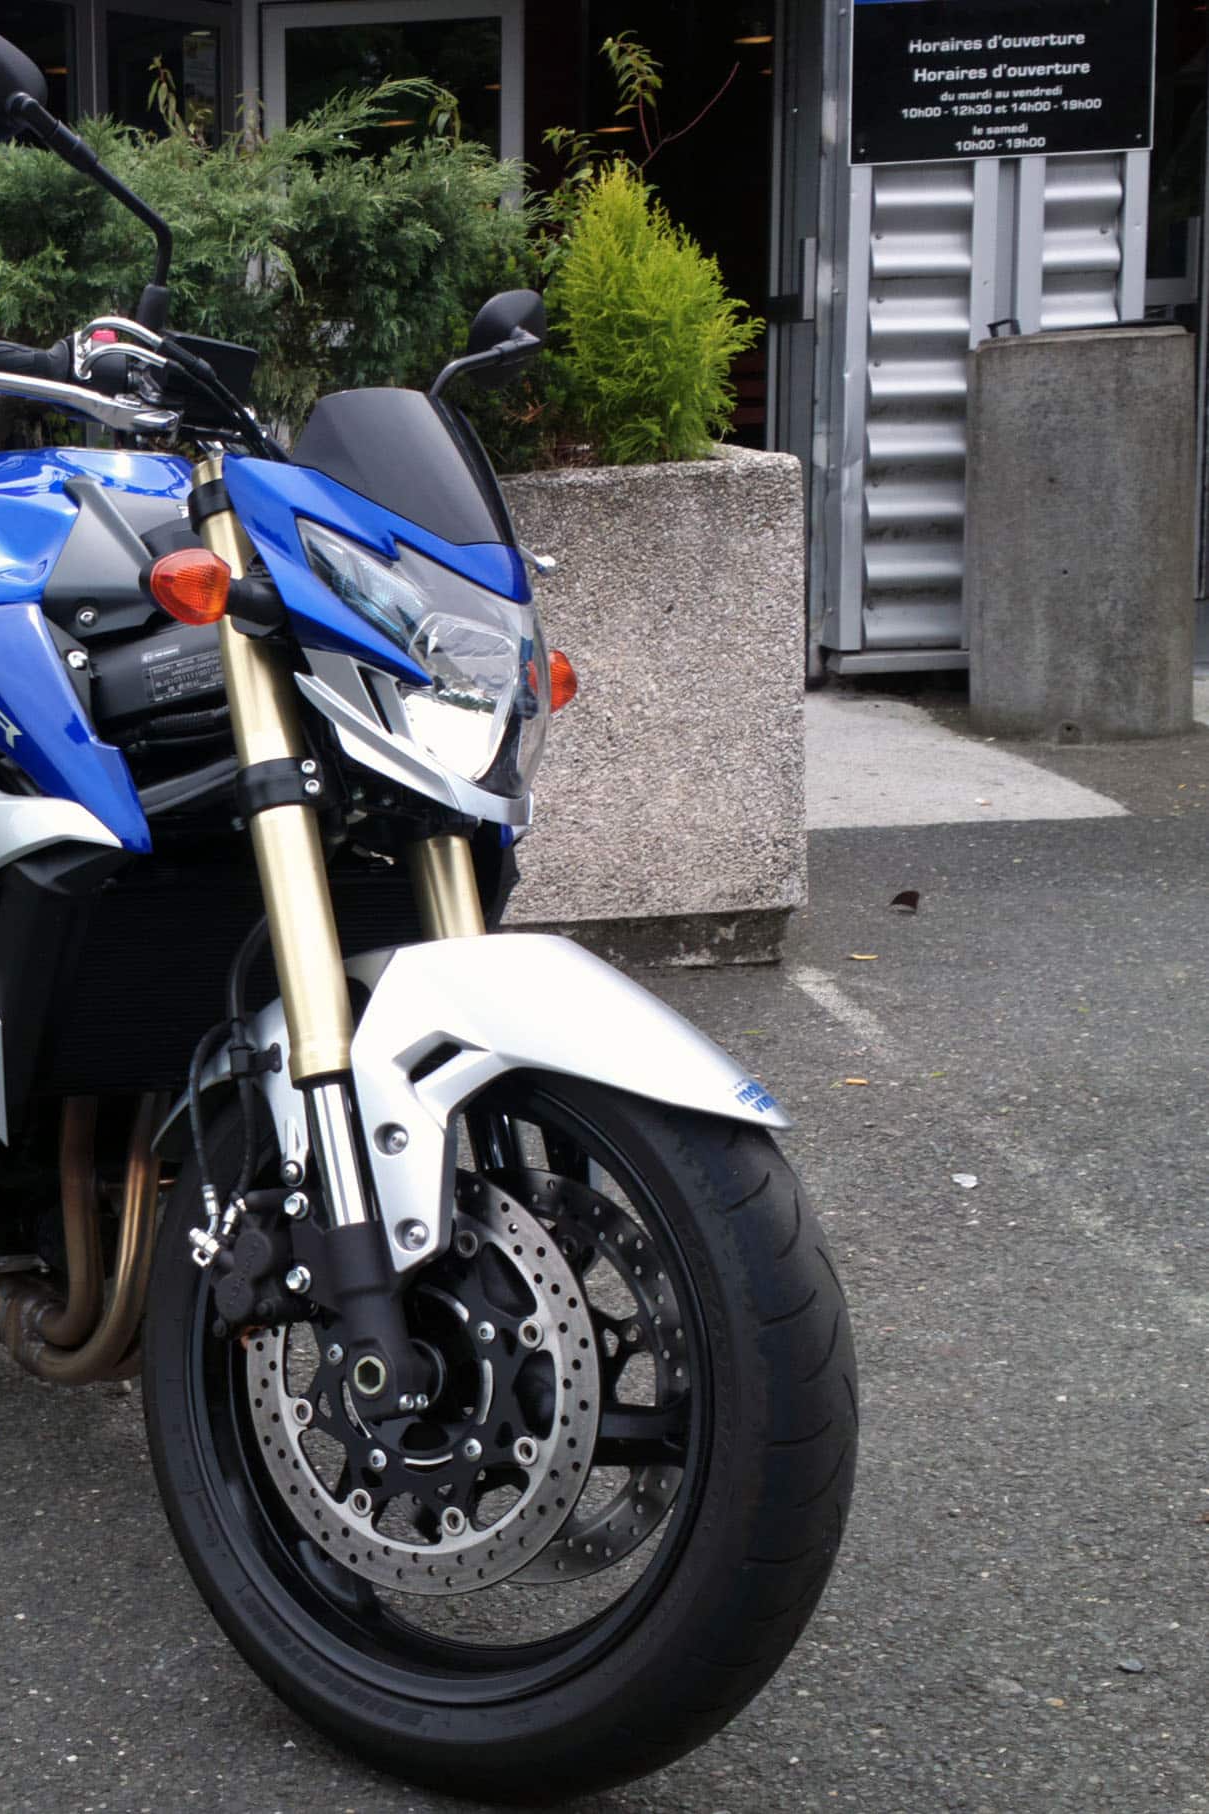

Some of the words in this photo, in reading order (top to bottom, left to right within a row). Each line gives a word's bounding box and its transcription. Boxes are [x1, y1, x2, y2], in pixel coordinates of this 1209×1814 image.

[909, 37, 983, 54] Horaires
[913, 66, 988, 82] Horaires
[940, 91, 955, 101] du
[957, 89, 992, 101] mardi
[994, 90, 1010, 99] au
[1012, 85, 1063, 98] vendredi
[901, 106, 942, 119] 10h00
[951, 104, 992, 117] 12h30
[994, 104, 1008, 114] et
[1011, 101, 1051, 113] 14h00
[1061, 98, 1102, 111] 19h00
[972, 125, 984, 136] le
[986, 122, 1029, 135] samedi
[955, 139, 996, 152] 10h00
[1005, 136, 1047, 149] 19h00
